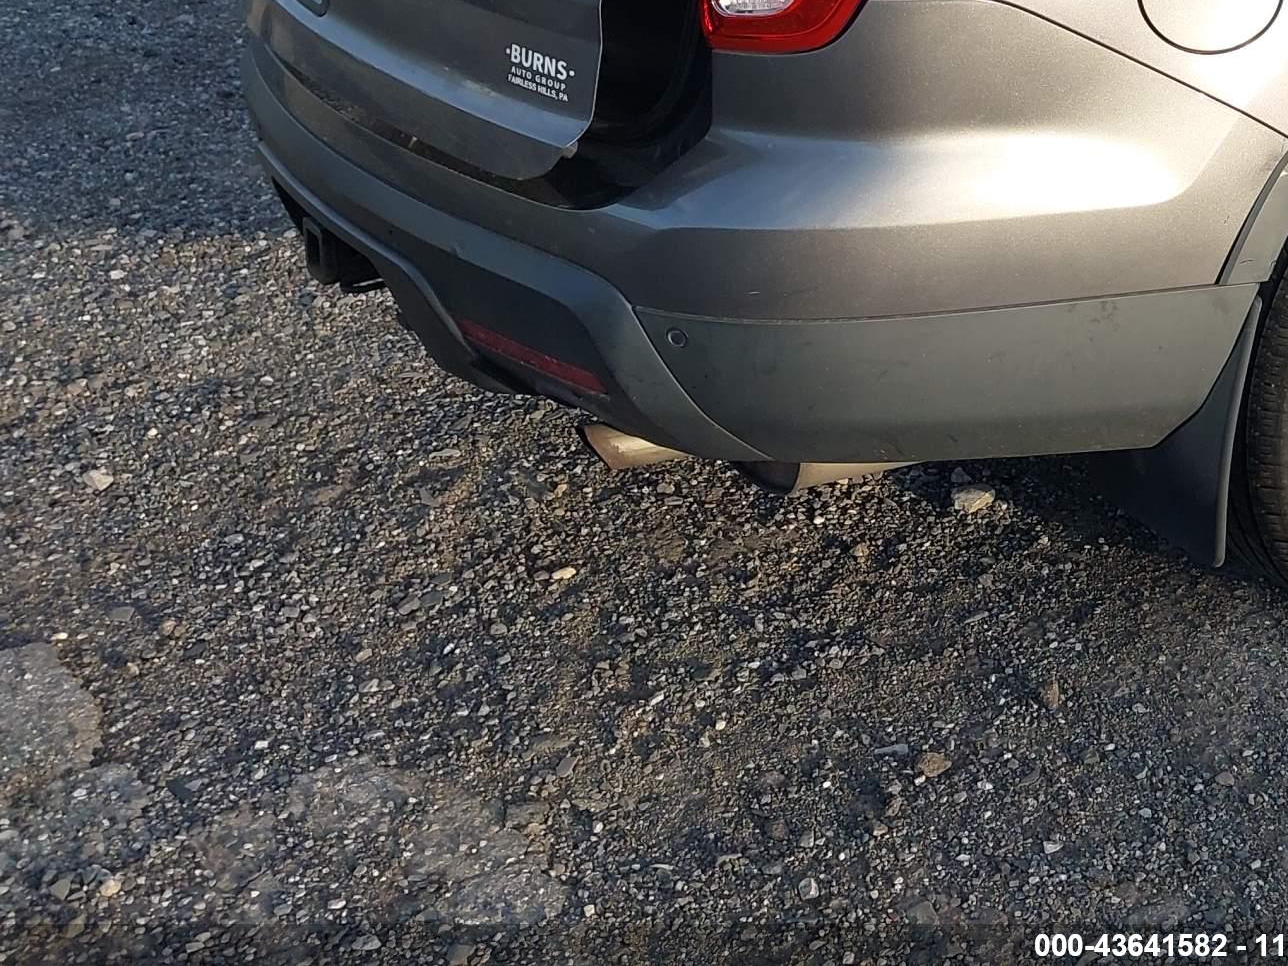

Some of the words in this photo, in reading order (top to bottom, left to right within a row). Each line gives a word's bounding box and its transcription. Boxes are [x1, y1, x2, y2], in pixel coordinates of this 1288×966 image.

[507, 73, 537, 92] FAIRLESS
[558, 91, 569, 102] PA
[511, 65, 532, 80] AUTO
[535, 74, 567, 92] GROUP
